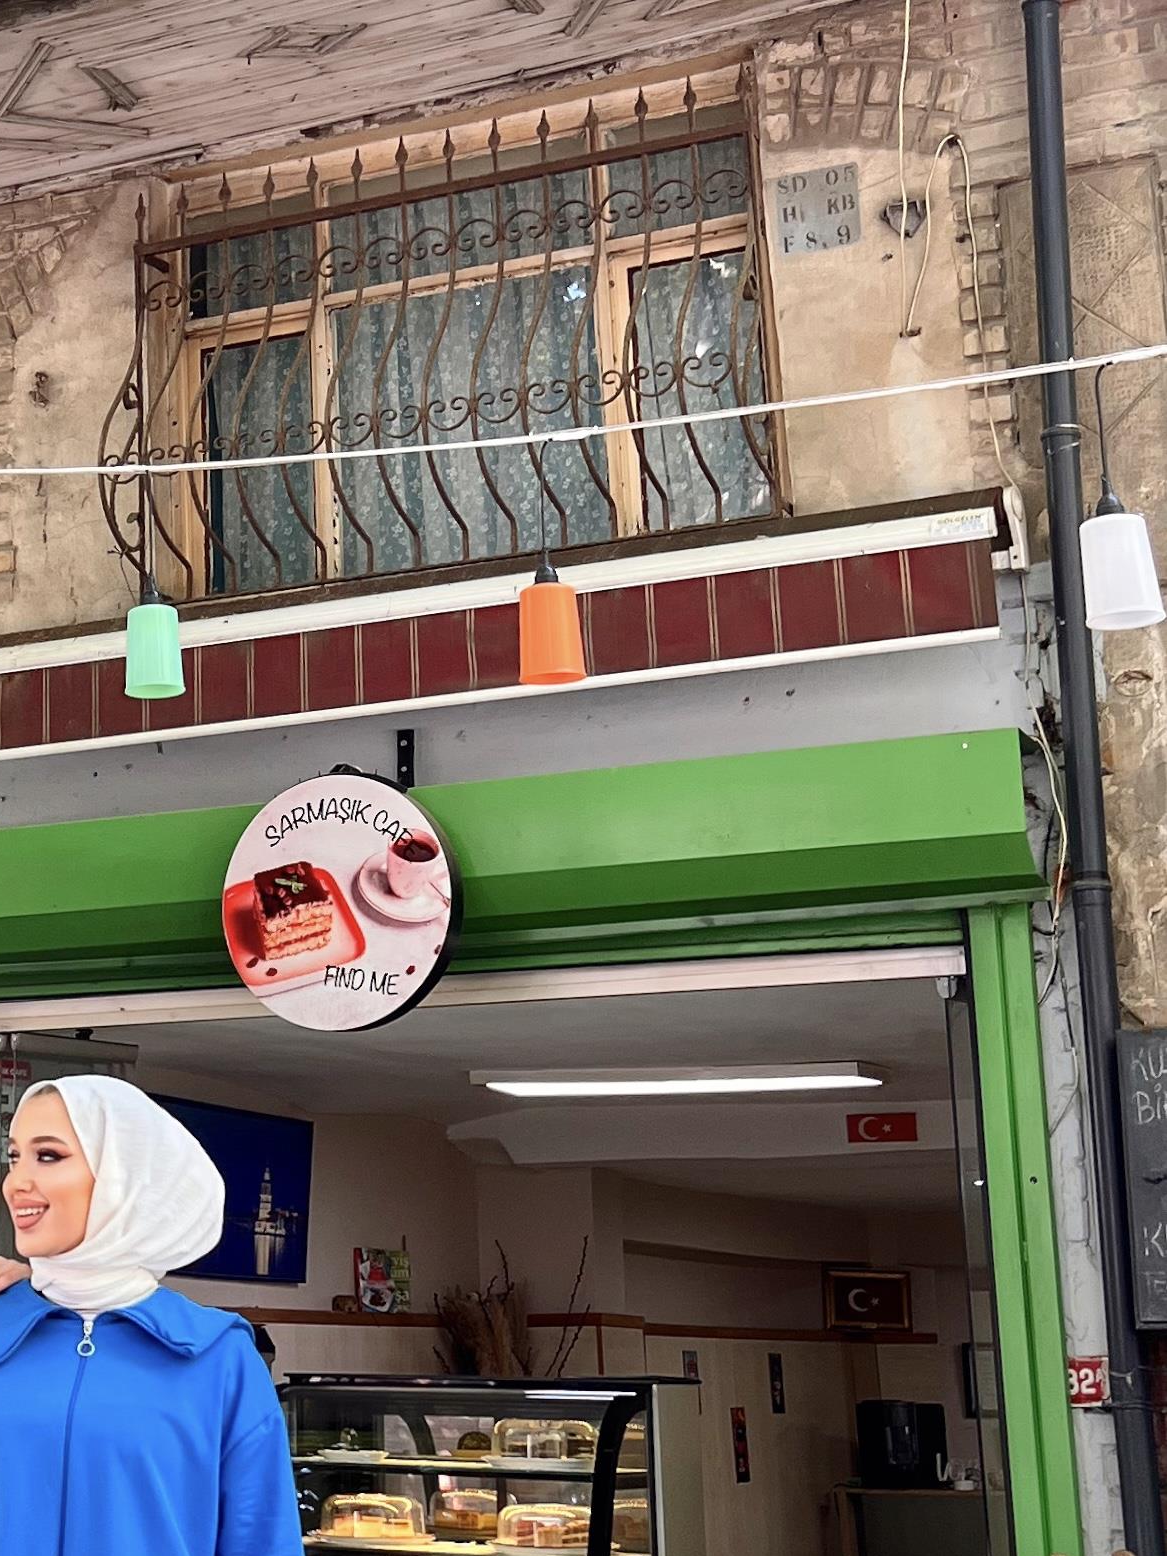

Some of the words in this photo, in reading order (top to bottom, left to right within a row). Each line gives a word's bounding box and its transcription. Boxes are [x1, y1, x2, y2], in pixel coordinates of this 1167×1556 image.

[265, 798, 372, 847] SARMAŞIK
[324, 965, 365, 991] FIND
[370, 972, 400, 995] ME
